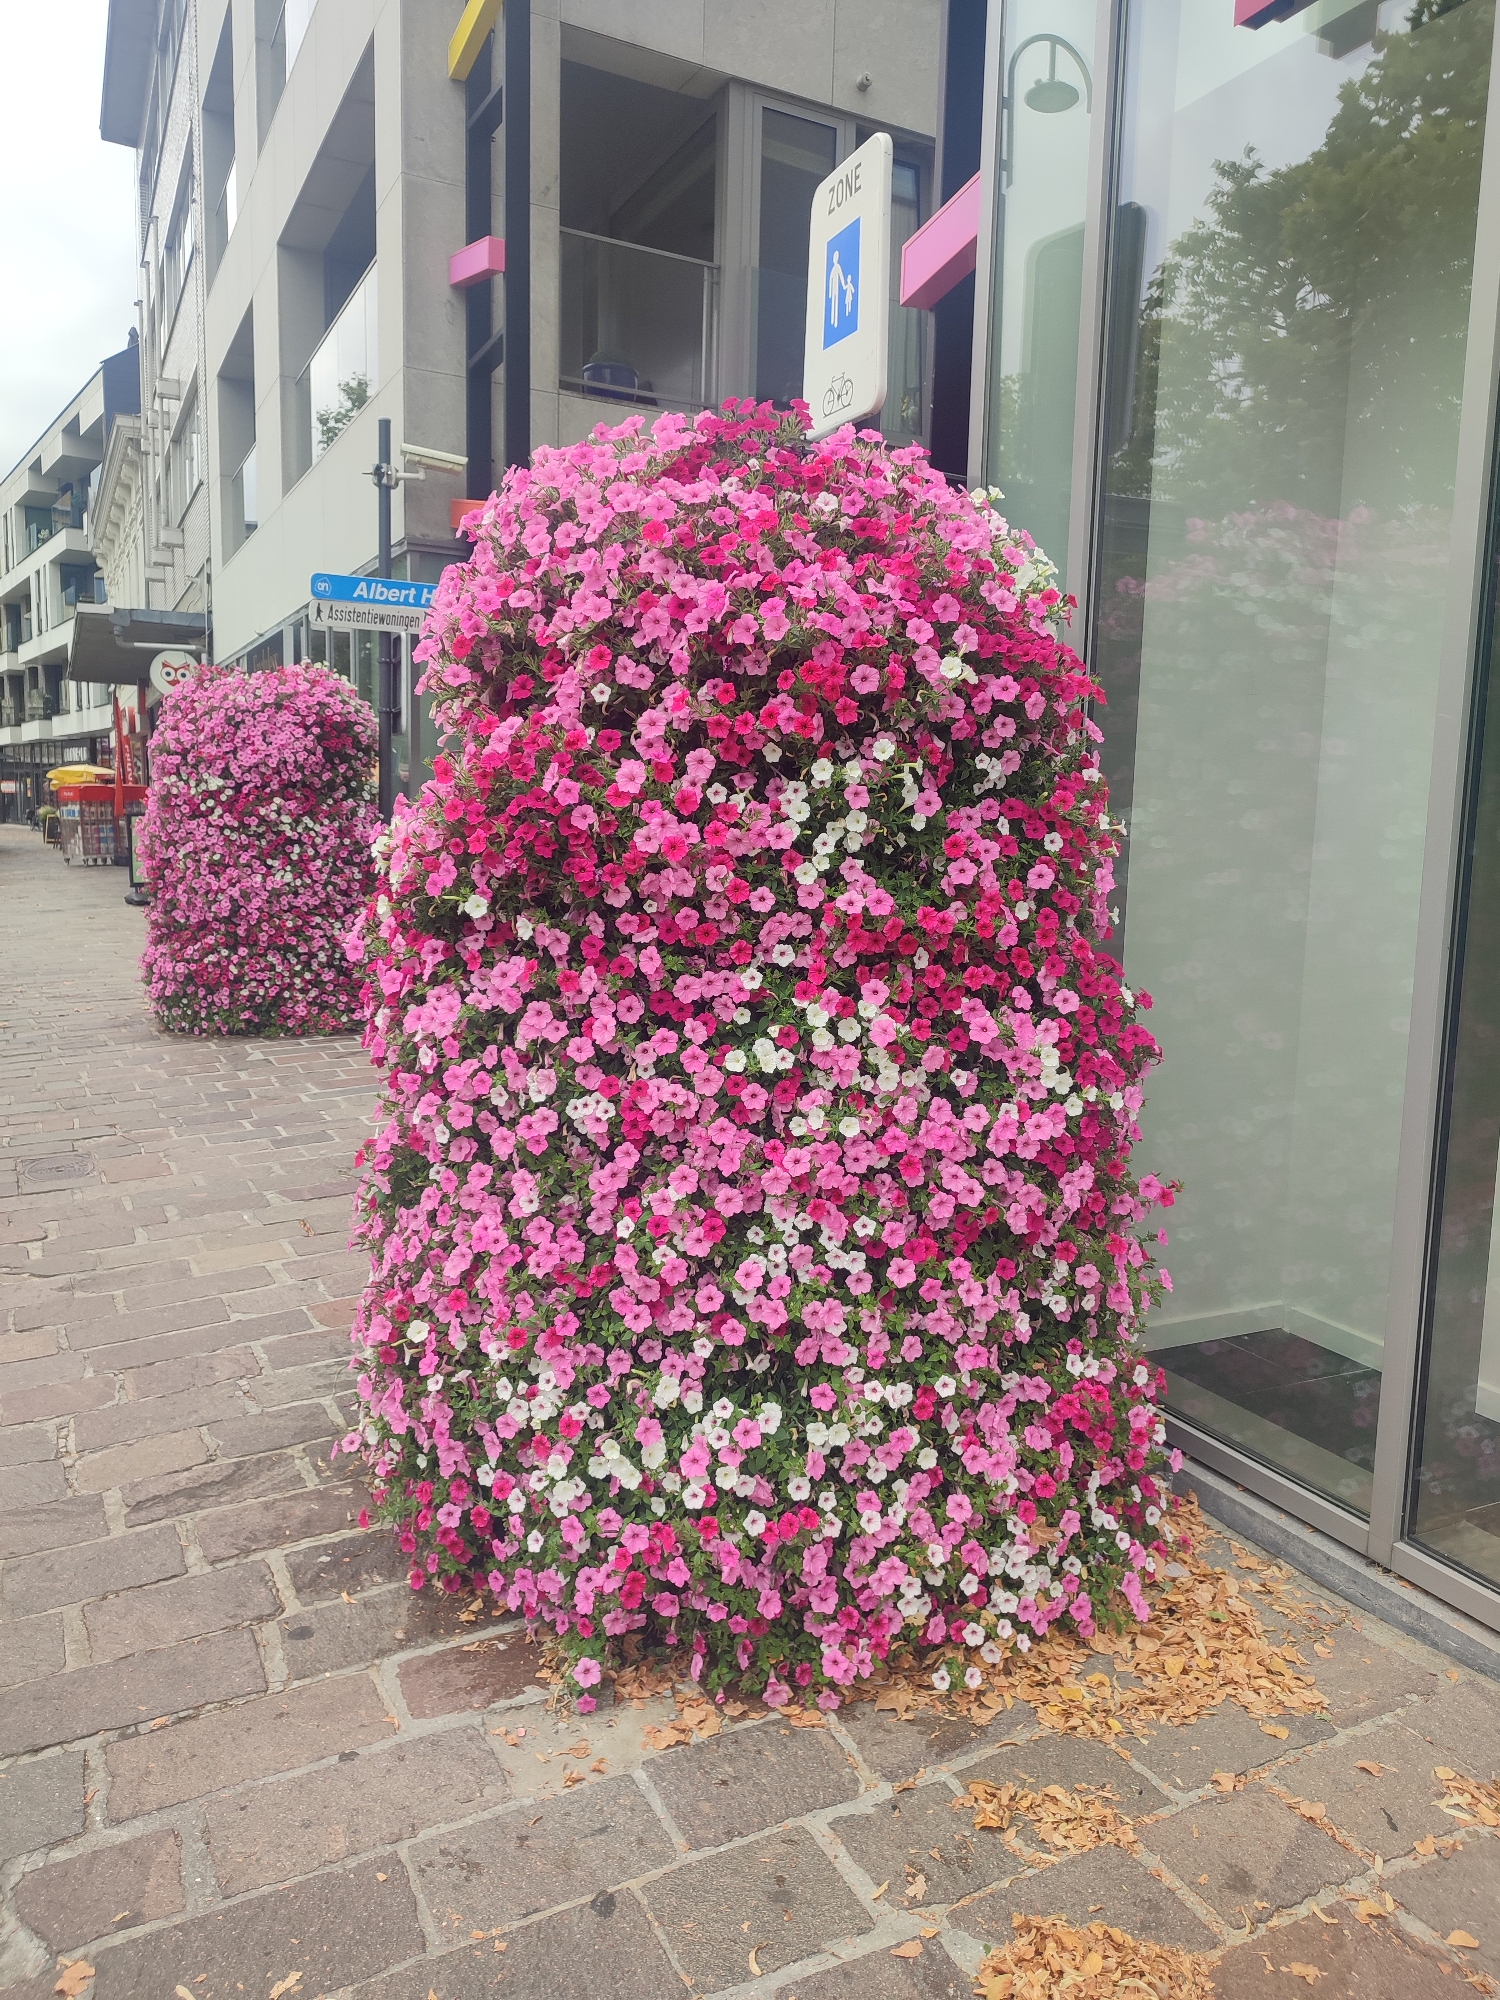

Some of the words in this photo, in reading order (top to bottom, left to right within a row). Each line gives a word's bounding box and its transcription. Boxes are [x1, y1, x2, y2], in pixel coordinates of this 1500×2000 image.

[828, 161, 862, 216] ZONE
[353, 581, 416, 603] Albert
[327, 604, 420, 631] Assistentiewoningen
